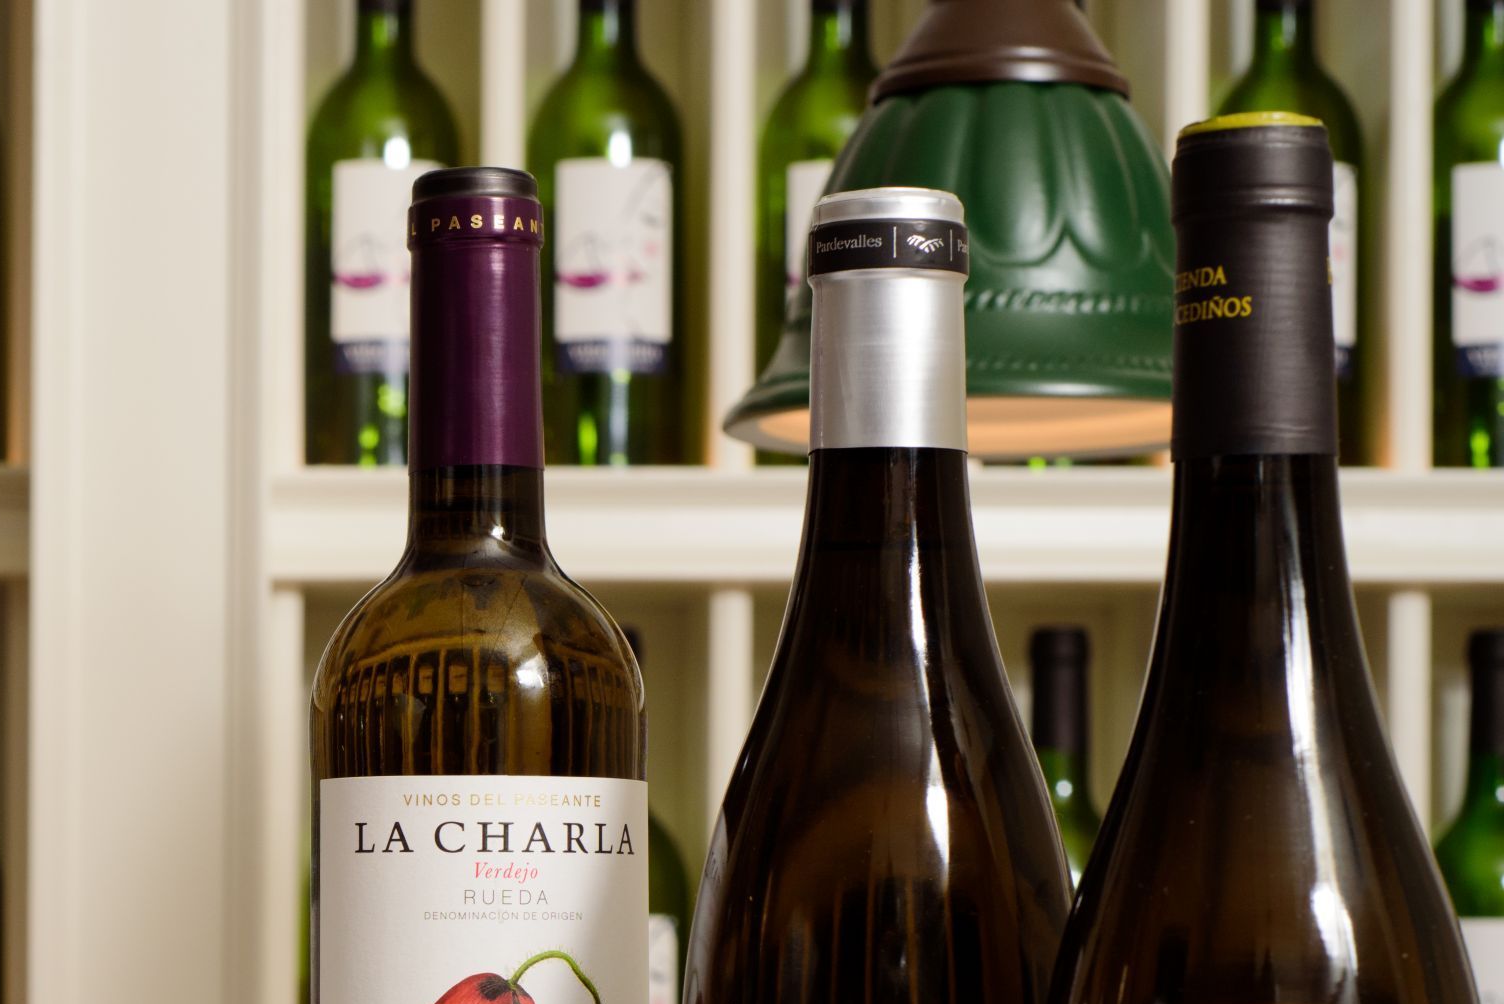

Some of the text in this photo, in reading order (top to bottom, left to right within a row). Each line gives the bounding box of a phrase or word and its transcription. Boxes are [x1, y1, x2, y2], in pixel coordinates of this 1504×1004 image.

[816, 234, 883, 254] Pardevalles
[403, 793, 601, 808] VINOS DEL PASEANTE
[354, 820, 635, 856] LA CHARLA
[473, 861, 539, 885] Verdejo
[463, 889, 549, 906] RUEDA
[523, 911, 539, 921] DE
[541, 911, 583, 922] ORIGEN
